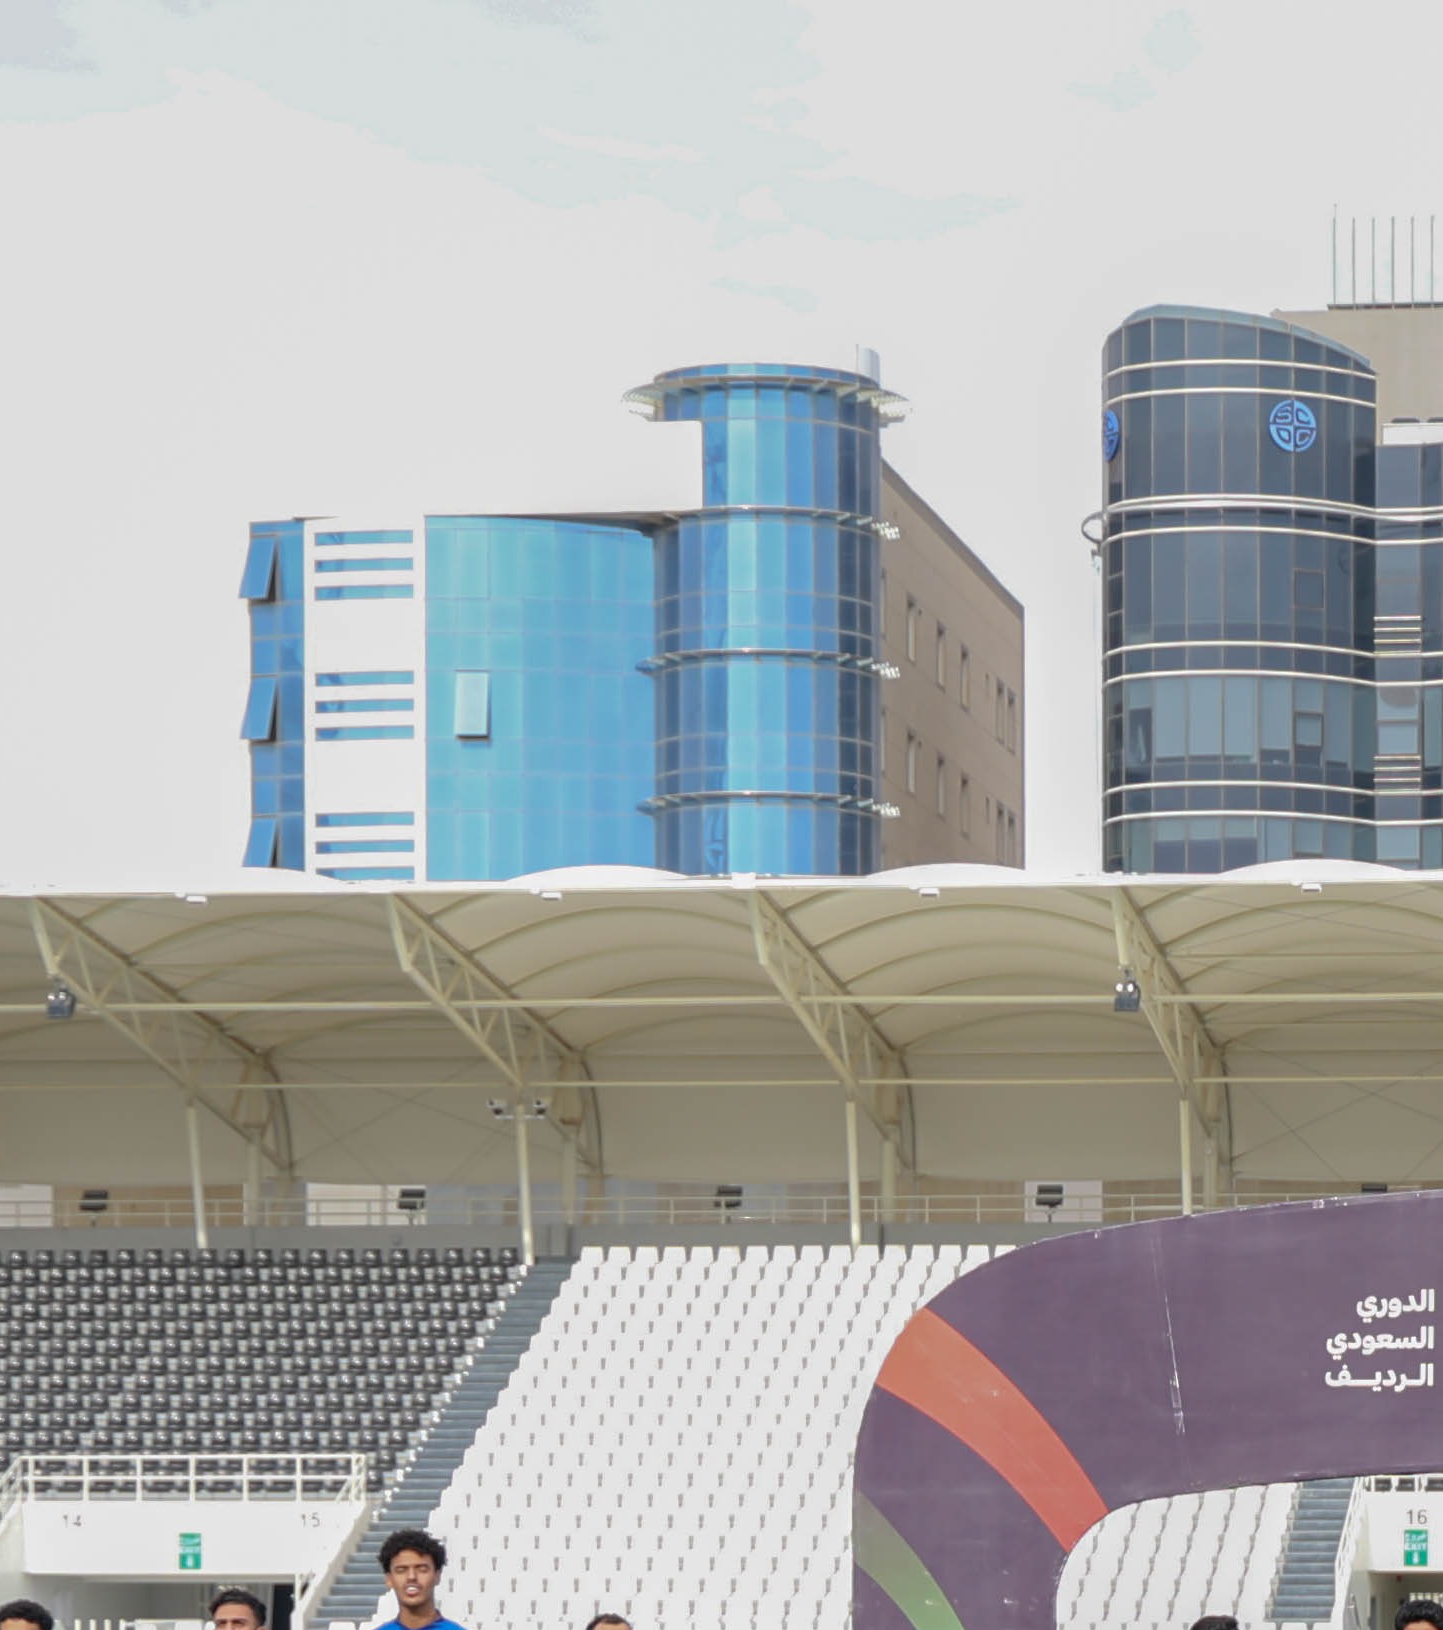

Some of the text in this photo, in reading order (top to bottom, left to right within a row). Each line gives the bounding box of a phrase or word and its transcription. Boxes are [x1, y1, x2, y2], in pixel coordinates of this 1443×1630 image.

[1356, 1289, 1435, 1322] الدوري
[1326, 1326, 1435, 1359] السعودي
[1324, 1362, 1435, 1393] الرديف
[1406, 1508, 1428, 1525] 16
